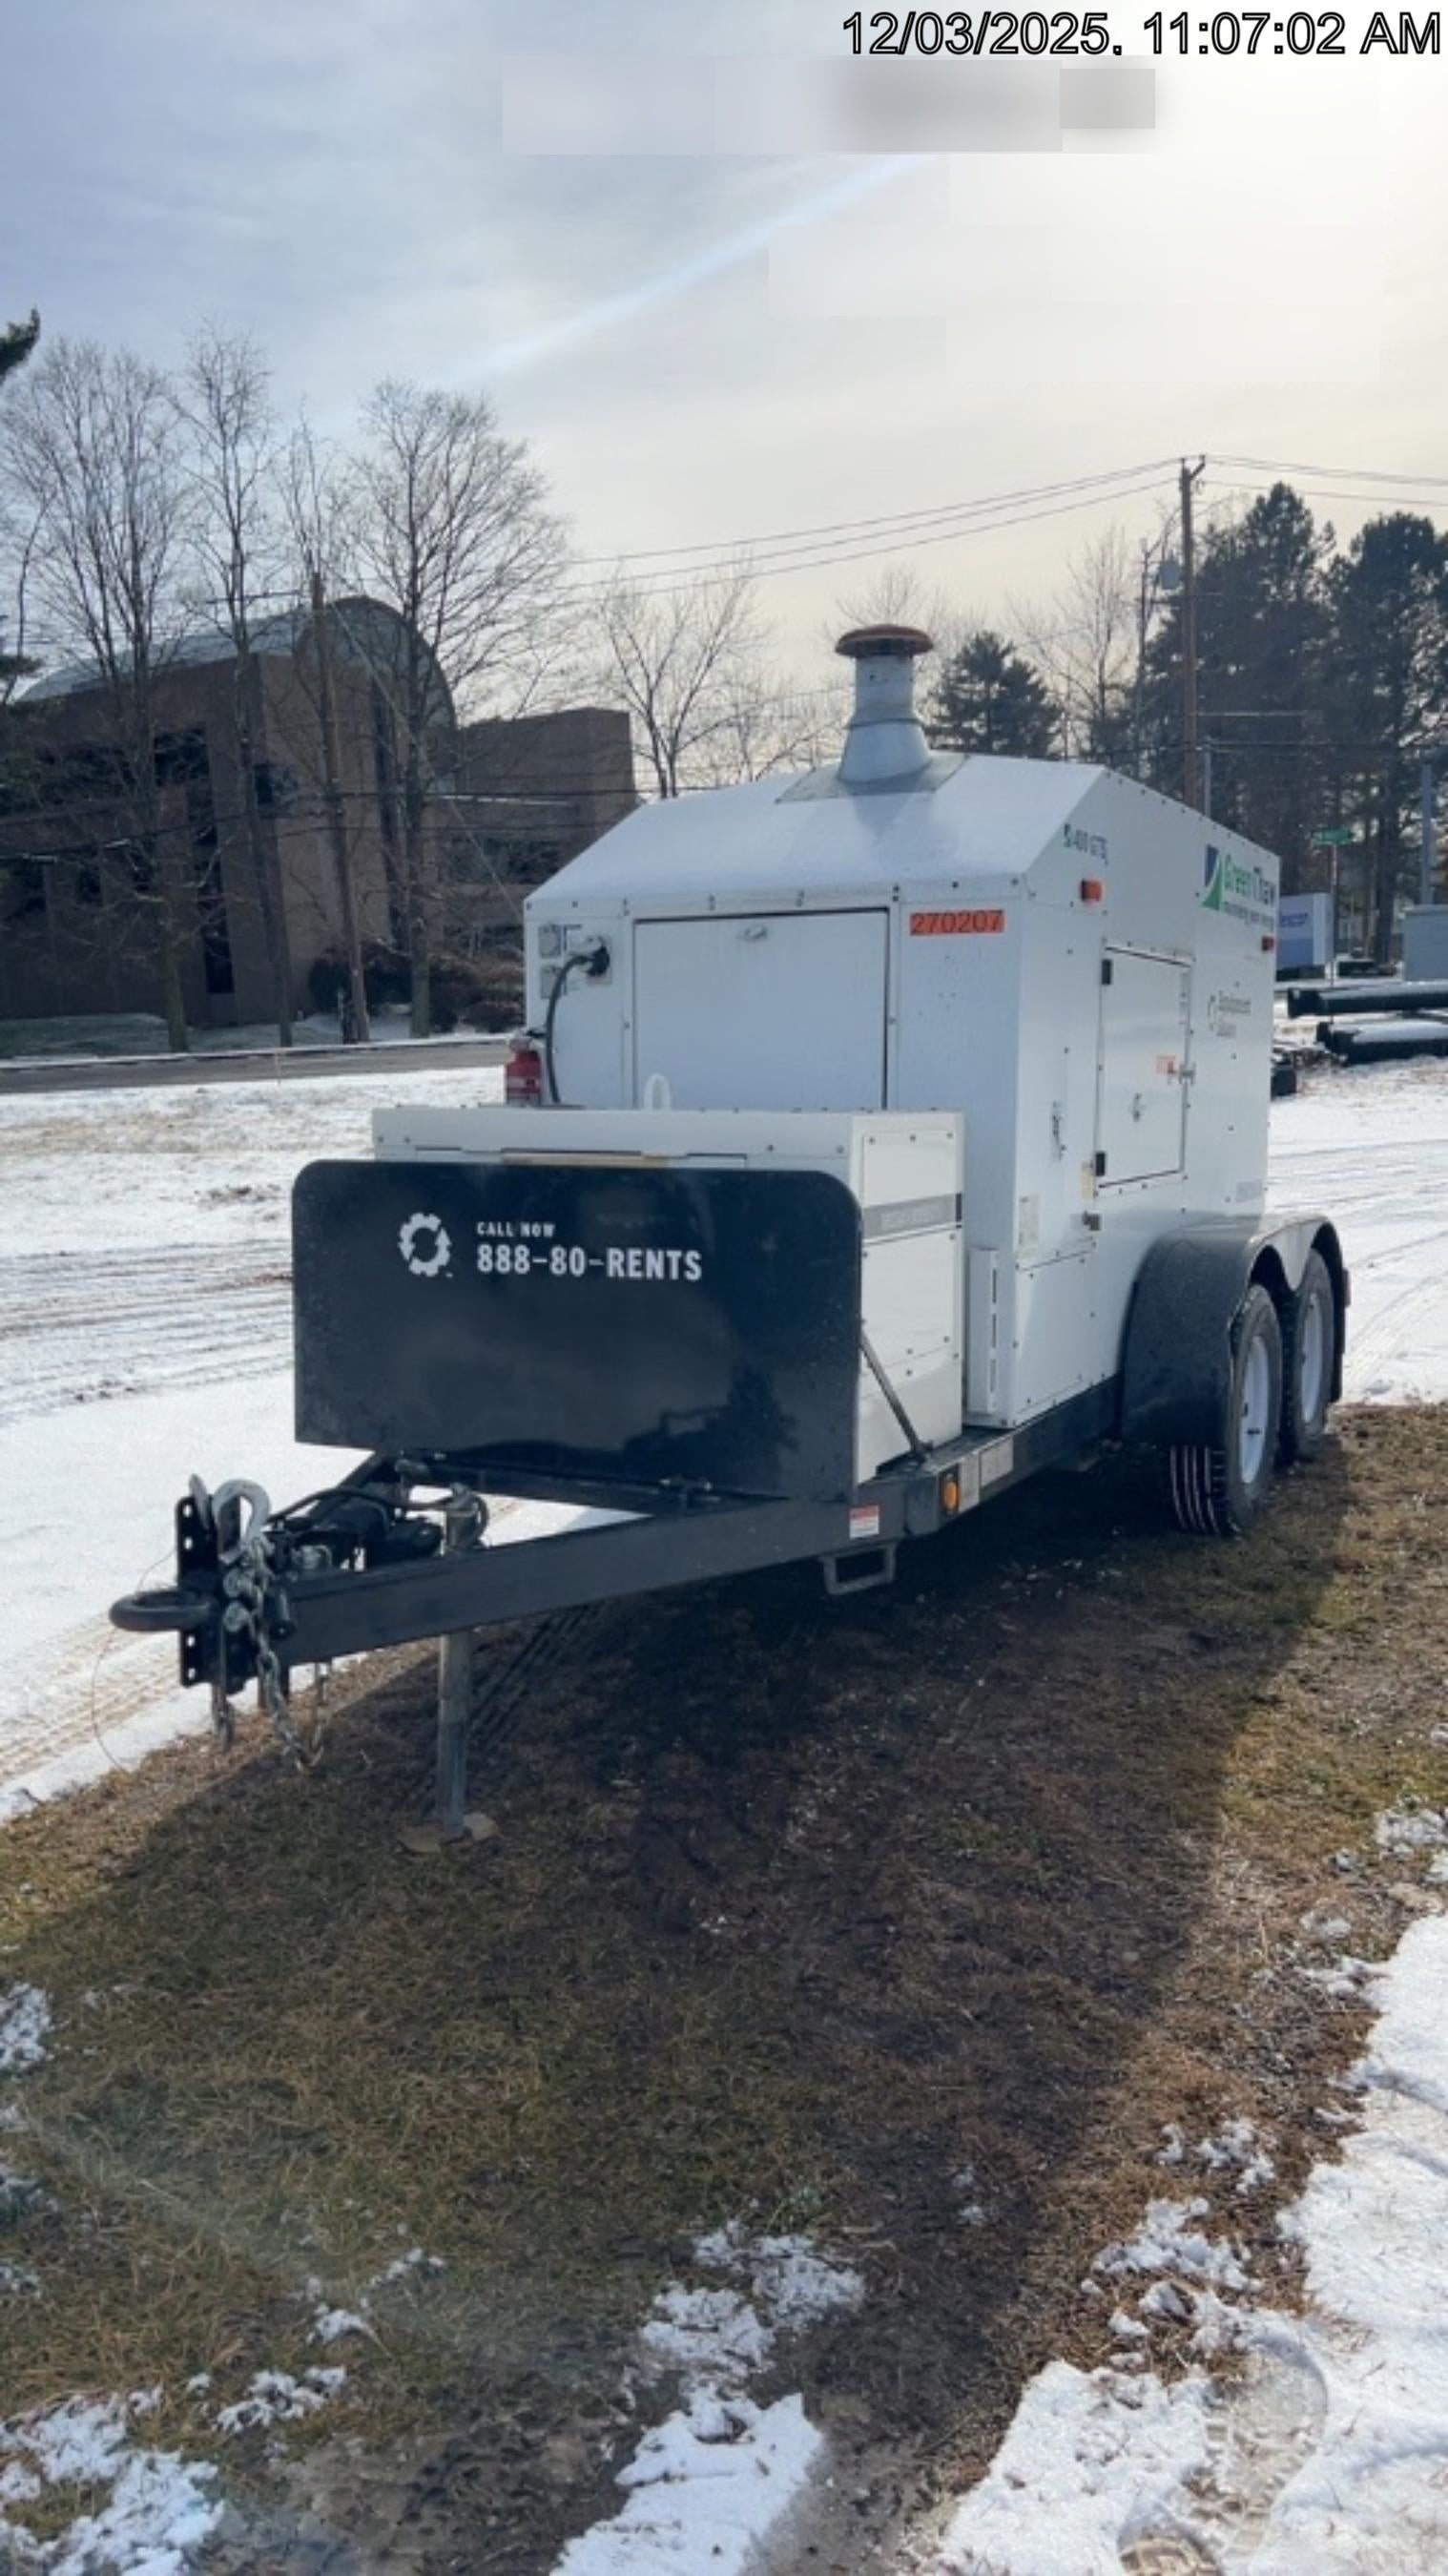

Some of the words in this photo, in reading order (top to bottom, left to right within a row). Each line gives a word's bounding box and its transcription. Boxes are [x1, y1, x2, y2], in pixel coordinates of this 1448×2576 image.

[912, 910, 1003, 934] 270207
[477, 1222, 514, 1236] CALL
[521, 1223, 554, 1236] NOW
[477, 1244, 701, 1280] 888-80-RENTS
